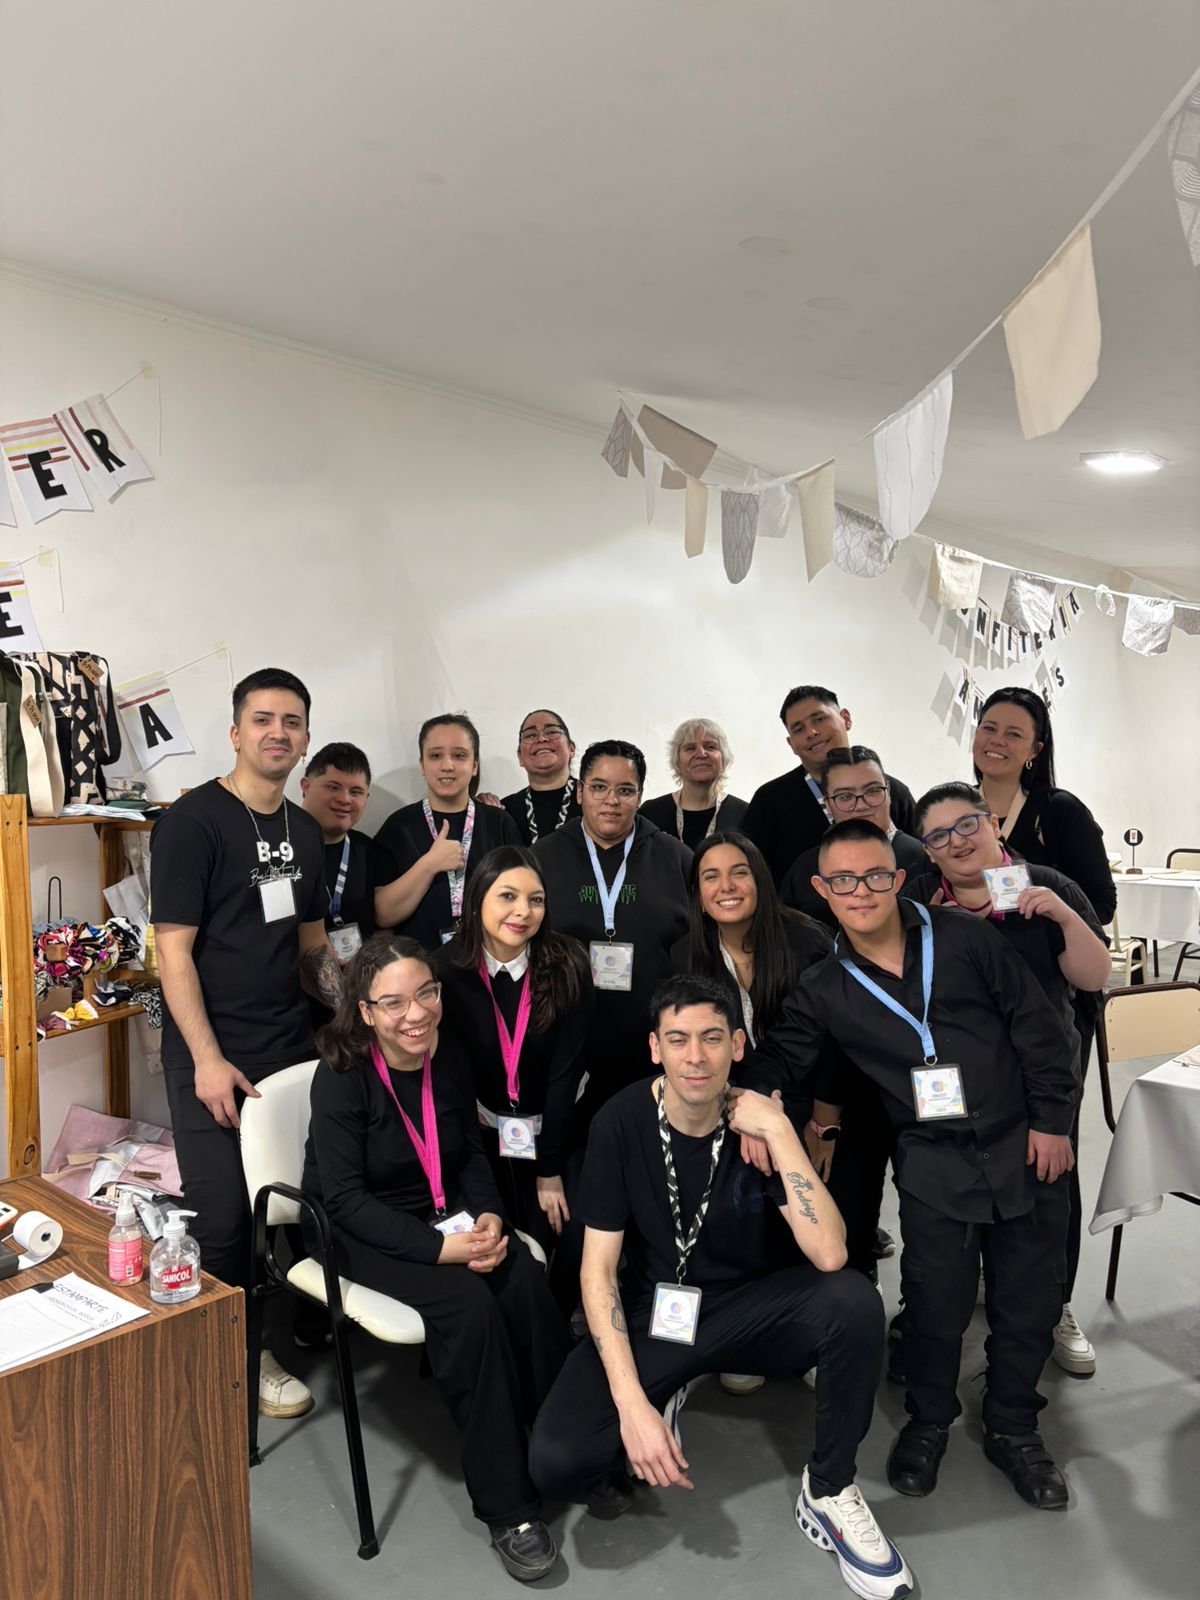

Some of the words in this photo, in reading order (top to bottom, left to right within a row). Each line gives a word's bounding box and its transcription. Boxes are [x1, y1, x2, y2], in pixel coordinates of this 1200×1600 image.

[138, 702, 174, 749] A
[256, 841, 294, 862] B-9
[579, 884, 637, 904] AUTTIC
[786, 1171, 818, 1225] Rodrigo
[161, 1269, 191, 1284] SANICOL
